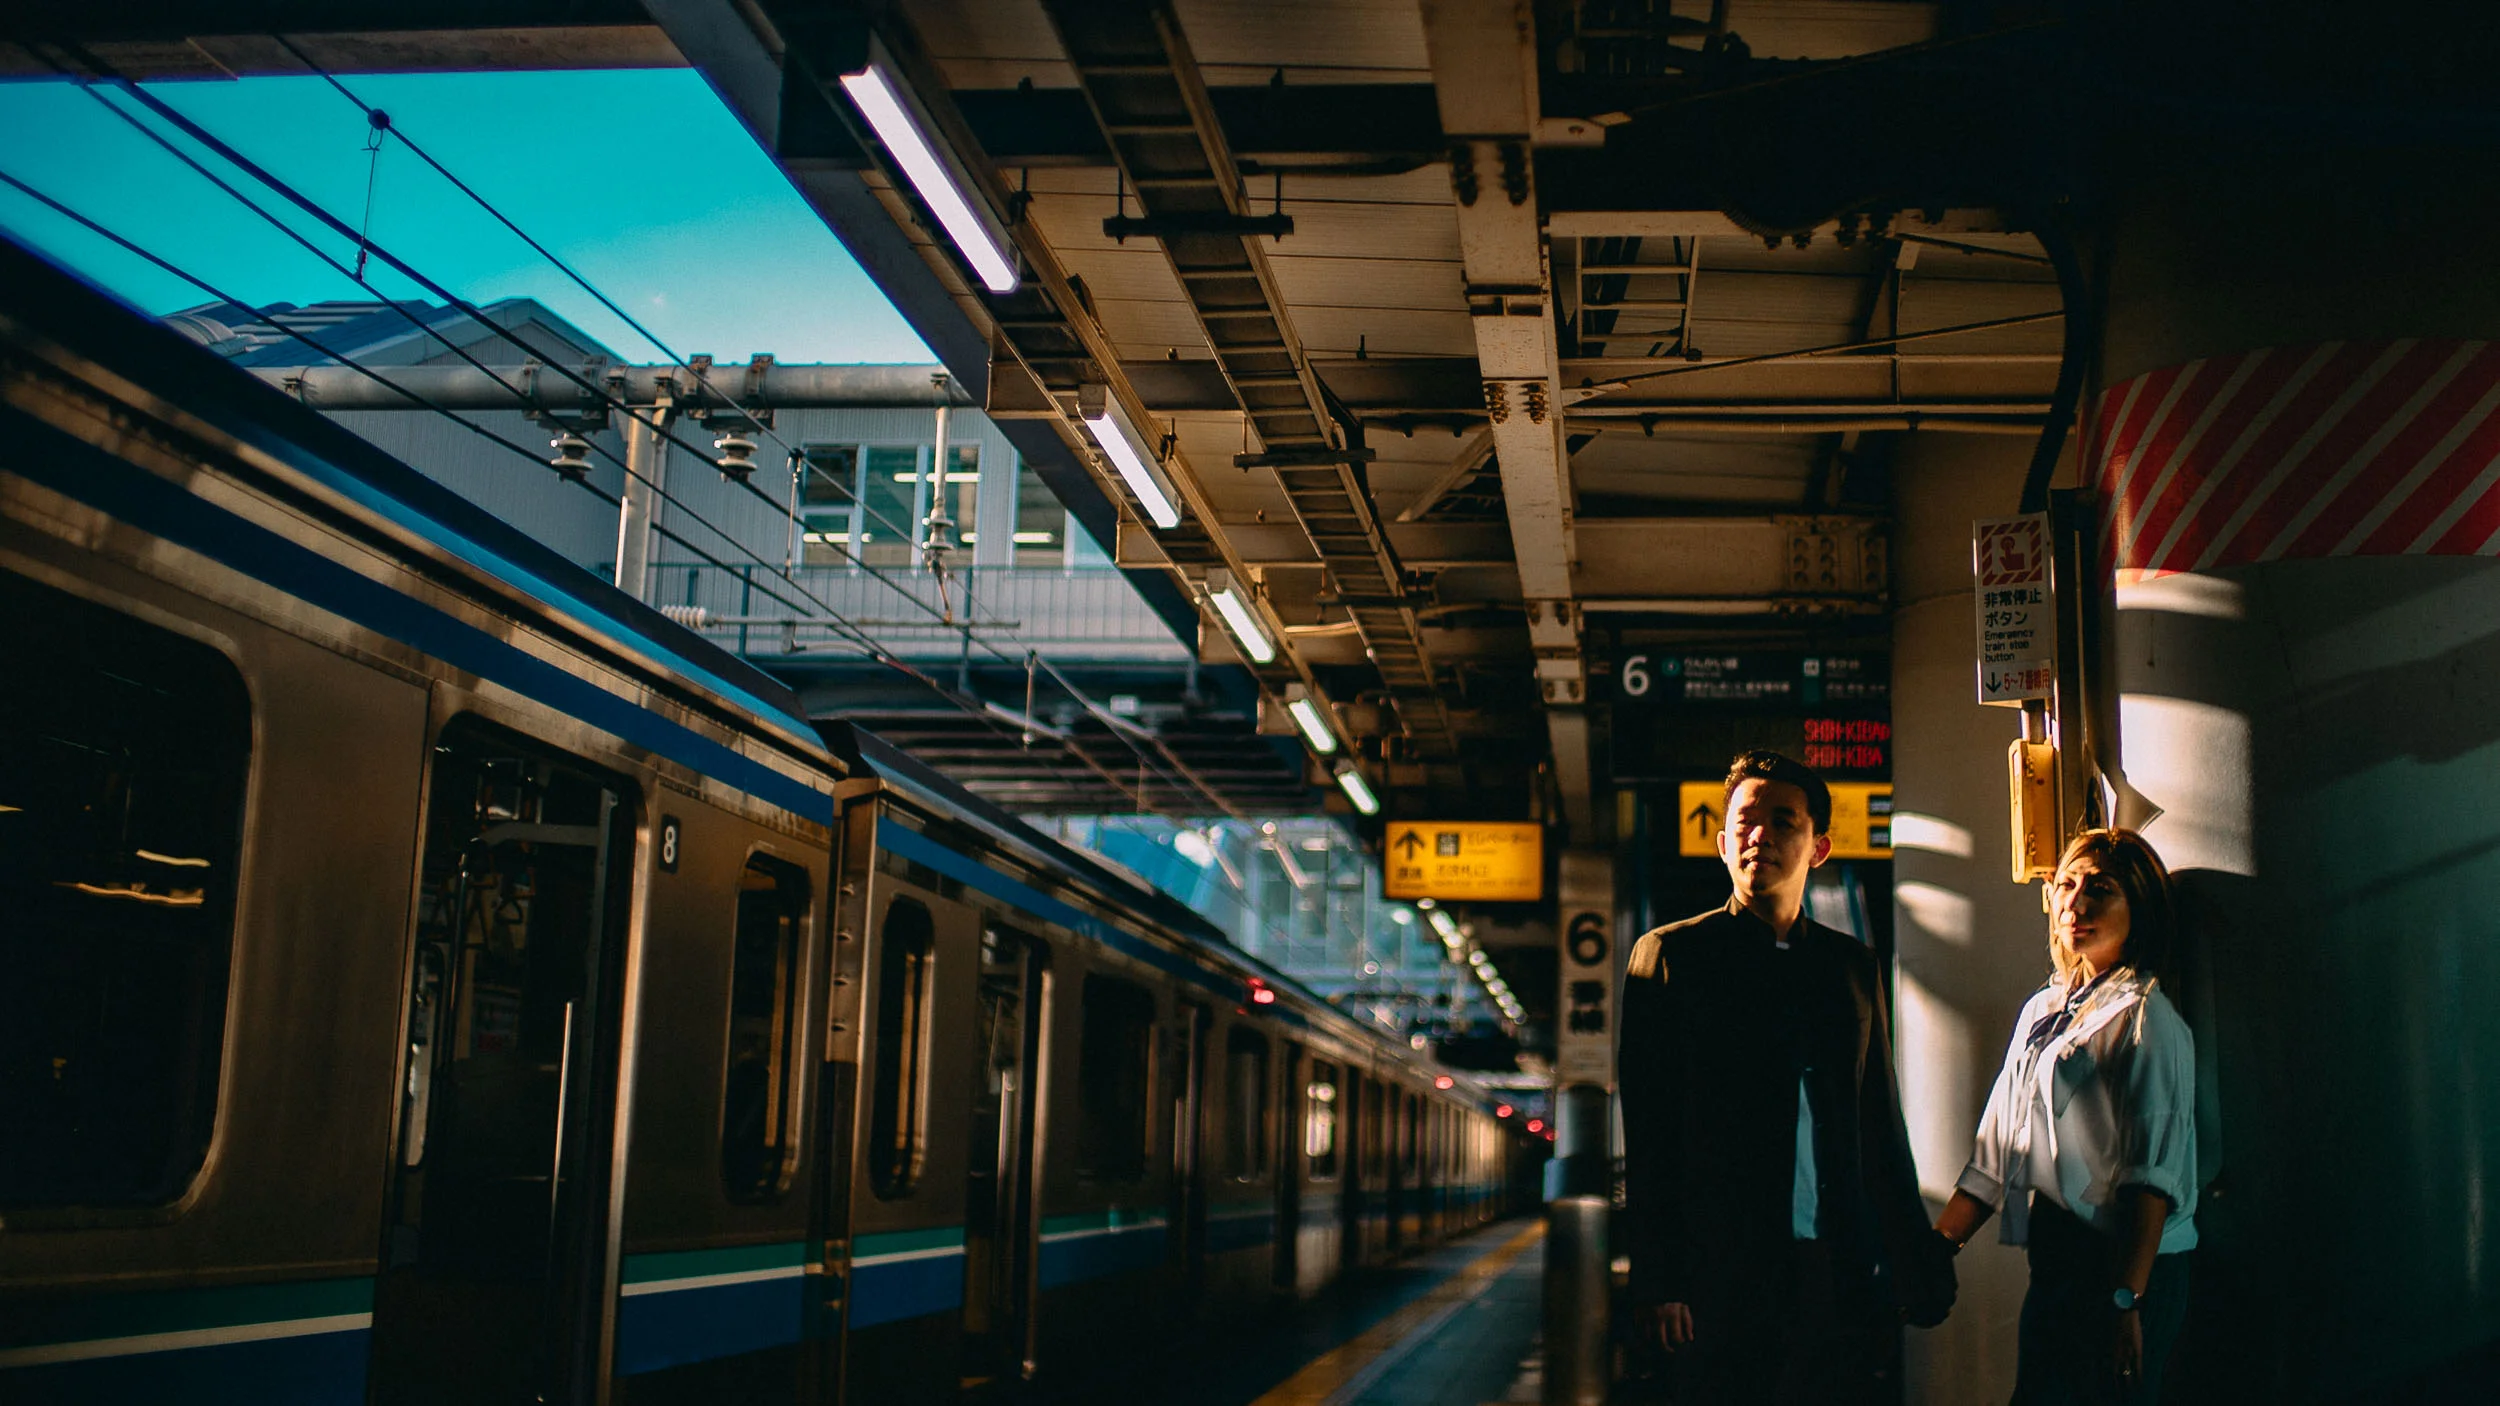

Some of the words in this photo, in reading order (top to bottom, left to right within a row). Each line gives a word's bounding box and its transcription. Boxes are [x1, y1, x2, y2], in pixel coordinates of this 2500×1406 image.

[1984, 588, 2042, 607] 非常停止
[1985, 611, 2027, 627] ボタン
[1985, 630, 2034, 640] Emergency
[1985, 641, 2005, 651] train
[2010, 639, 2030, 649] stop
[1985, 653, 2015, 662] button
[1622, 655, 1650, 696] 6
[1804, 745, 1883, 768] SHIN-KIBA
[663, 825, 676, 864] 8
[1569, 912, 1606, 966] 6
